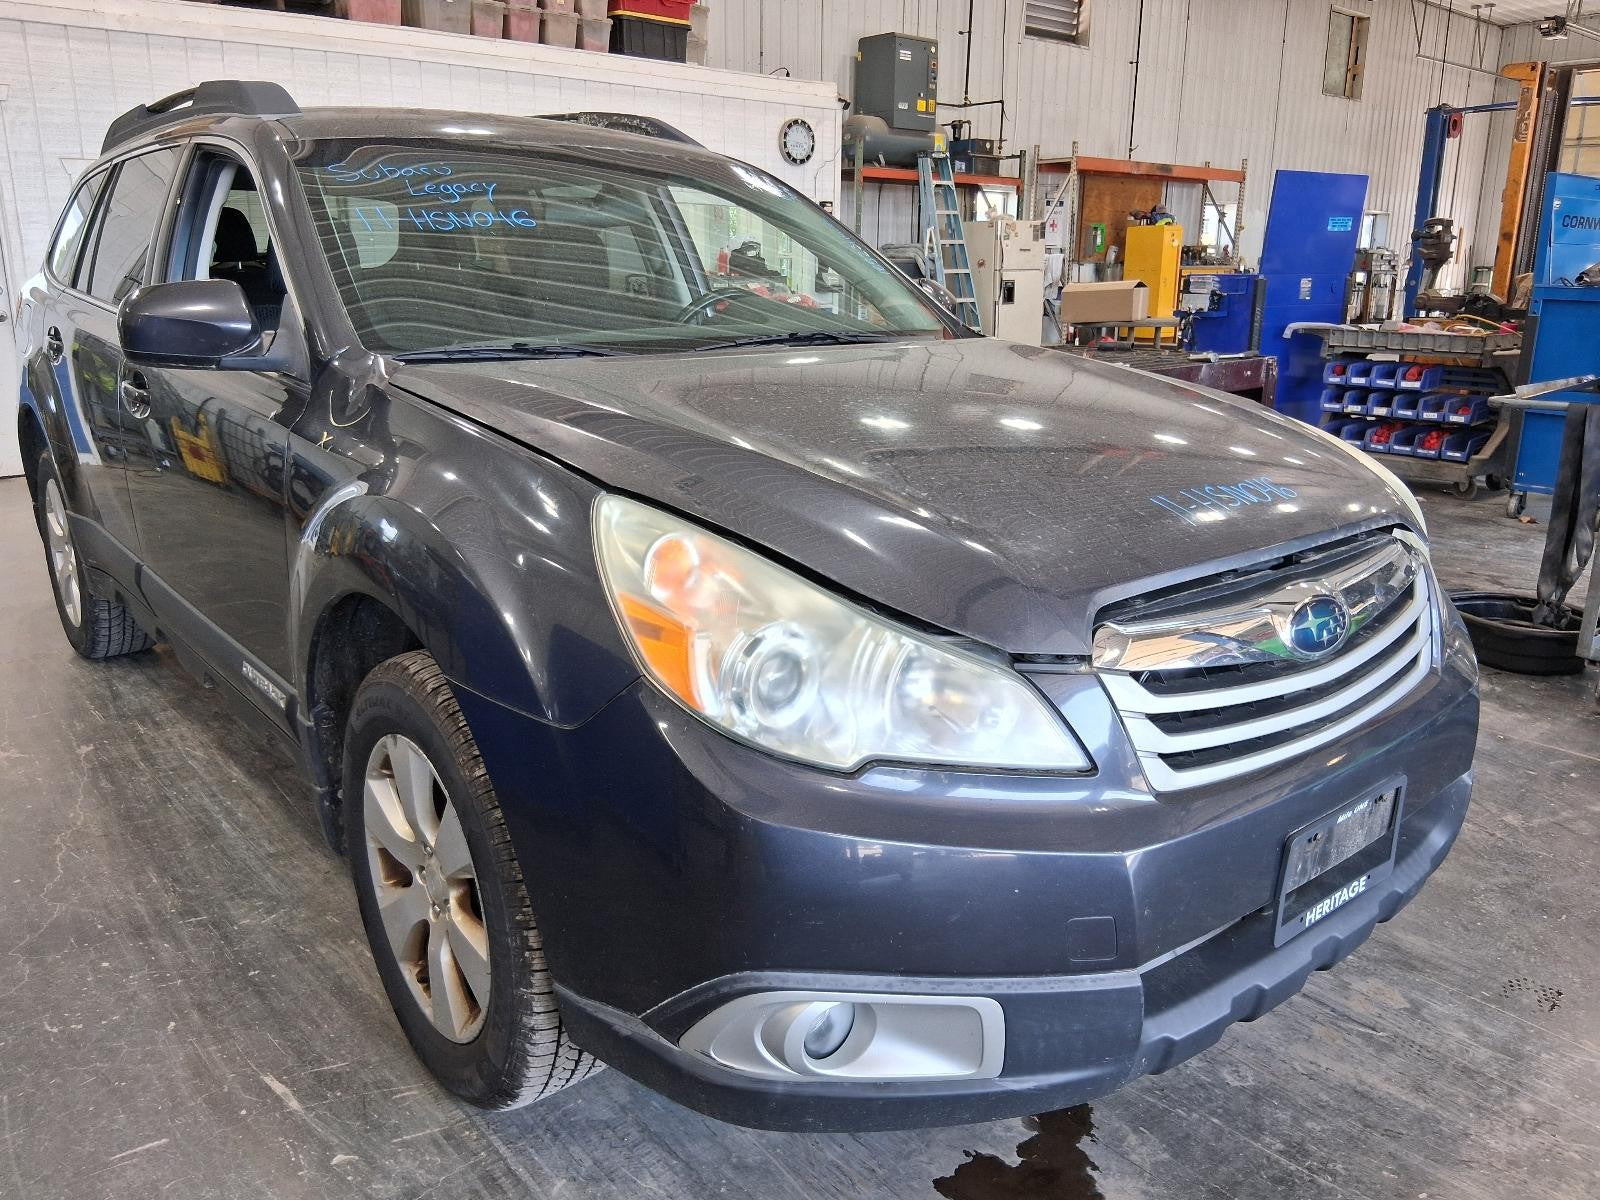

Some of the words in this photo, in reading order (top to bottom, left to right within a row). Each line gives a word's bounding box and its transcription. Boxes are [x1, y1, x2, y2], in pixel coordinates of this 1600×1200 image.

[405, 179, 498, 204] Legacy
[407, 207, 538, 231] HSN046
[1304, 875, 1367, 927] HERITAGE
